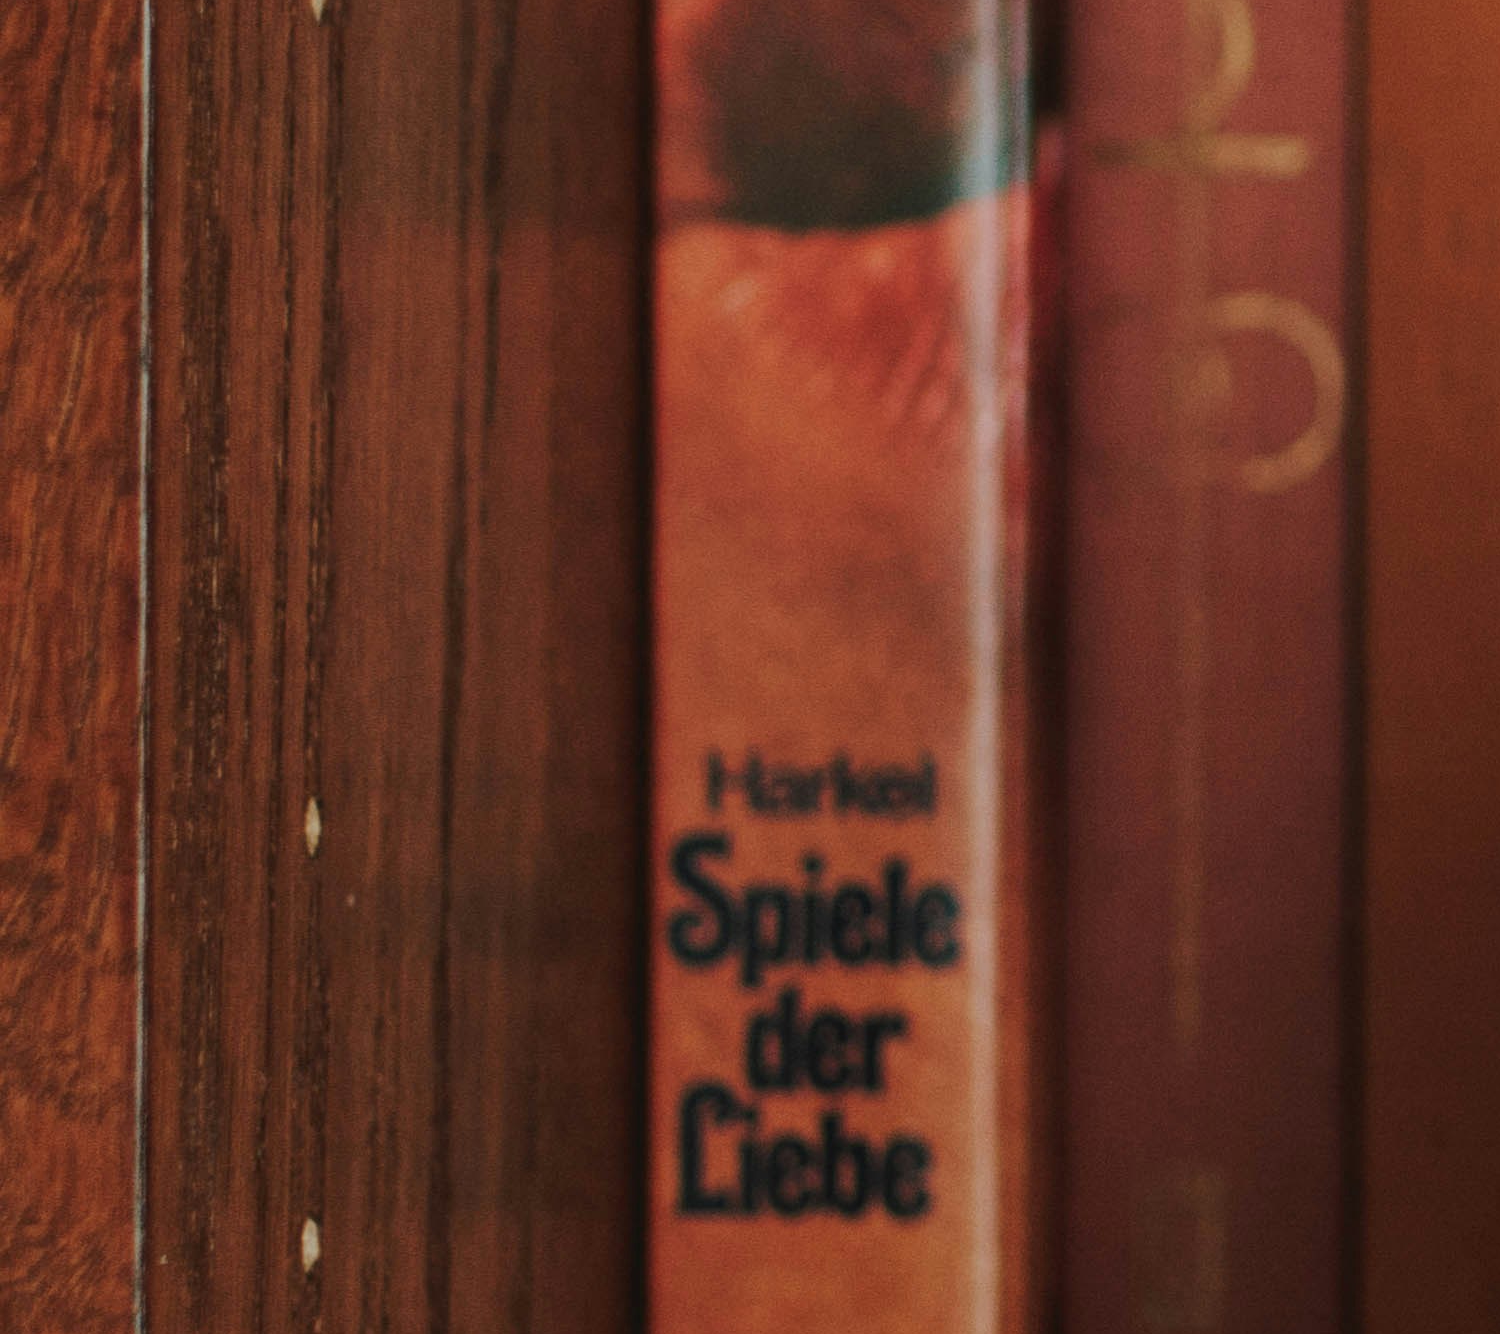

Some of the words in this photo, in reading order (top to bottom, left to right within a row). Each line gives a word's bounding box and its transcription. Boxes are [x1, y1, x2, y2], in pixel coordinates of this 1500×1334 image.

[668, 830, 961, 990] Spiele
[743, 985, 908, 1094] der
[675, 1079, 935, 1219] Liebe
